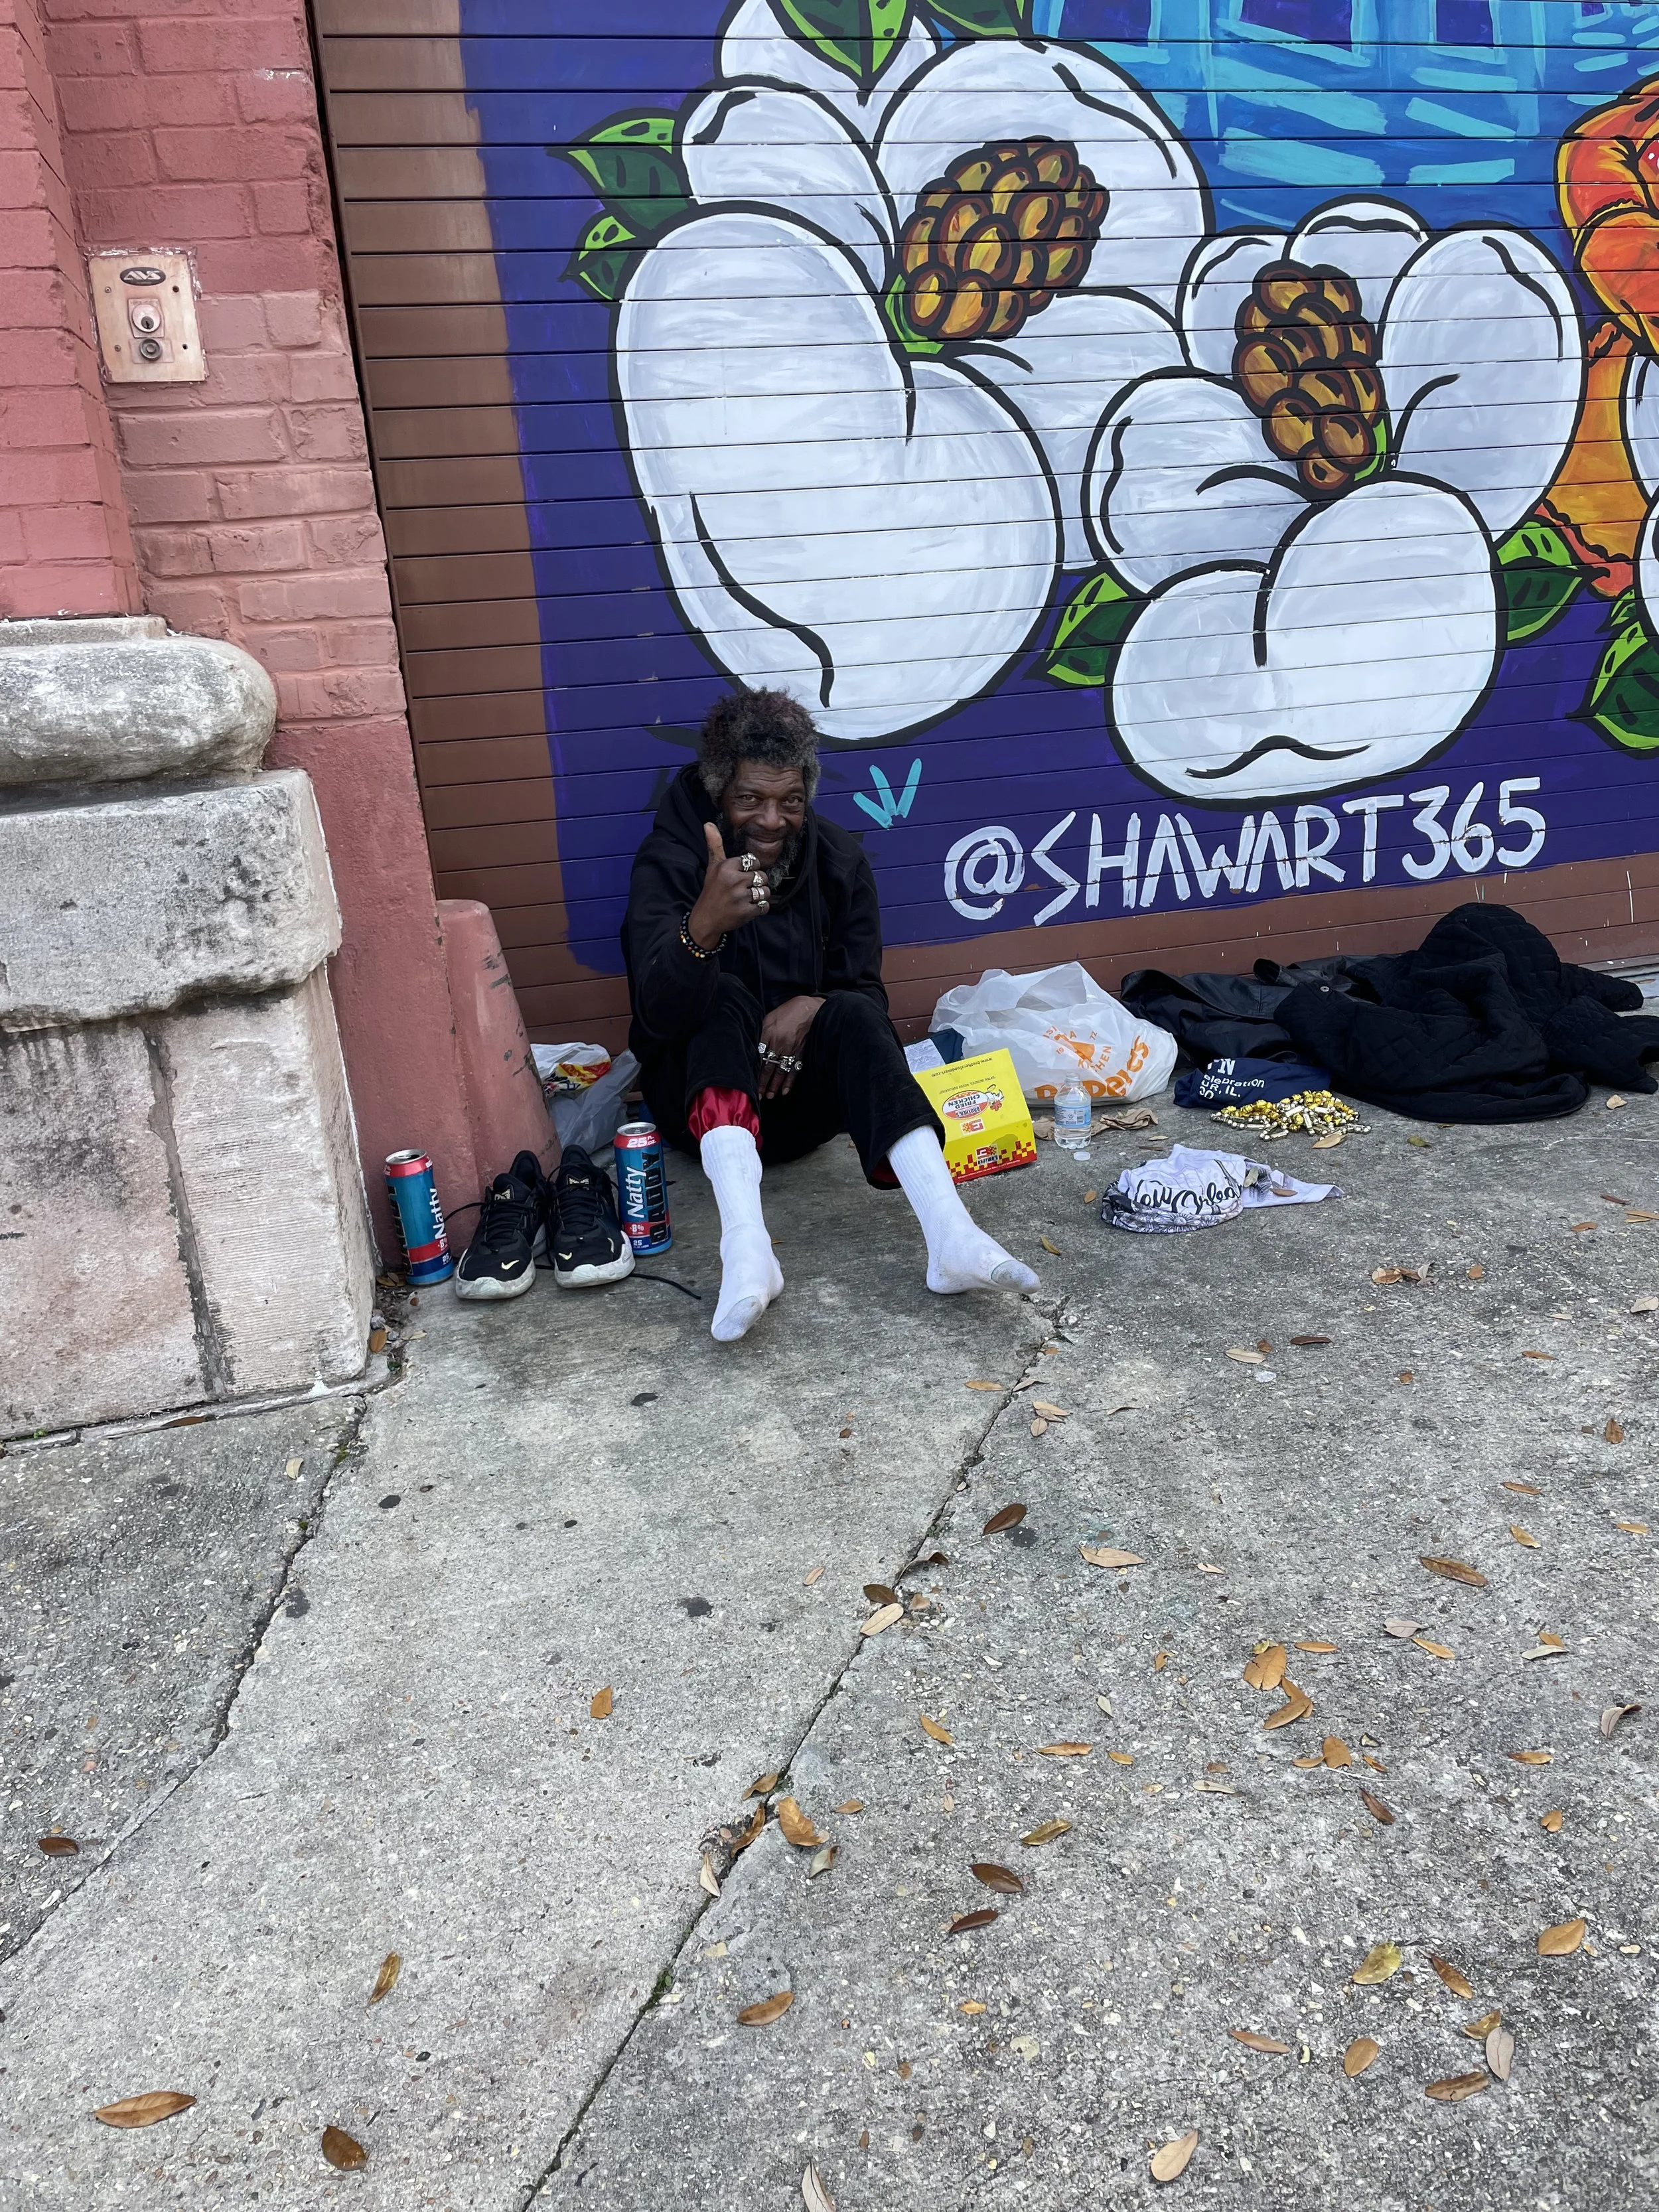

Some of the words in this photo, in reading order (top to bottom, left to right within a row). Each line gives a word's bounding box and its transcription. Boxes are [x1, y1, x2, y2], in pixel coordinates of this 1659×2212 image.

[1204, 1074, 1265, 1088] elebration
[948, 1094, 981, 1107] CHICKEN
[955, 1100, 976, 1109] FRIED
[626, 1136, 648, 1148] 25
[626, 1166, 647, 1218] Natty
